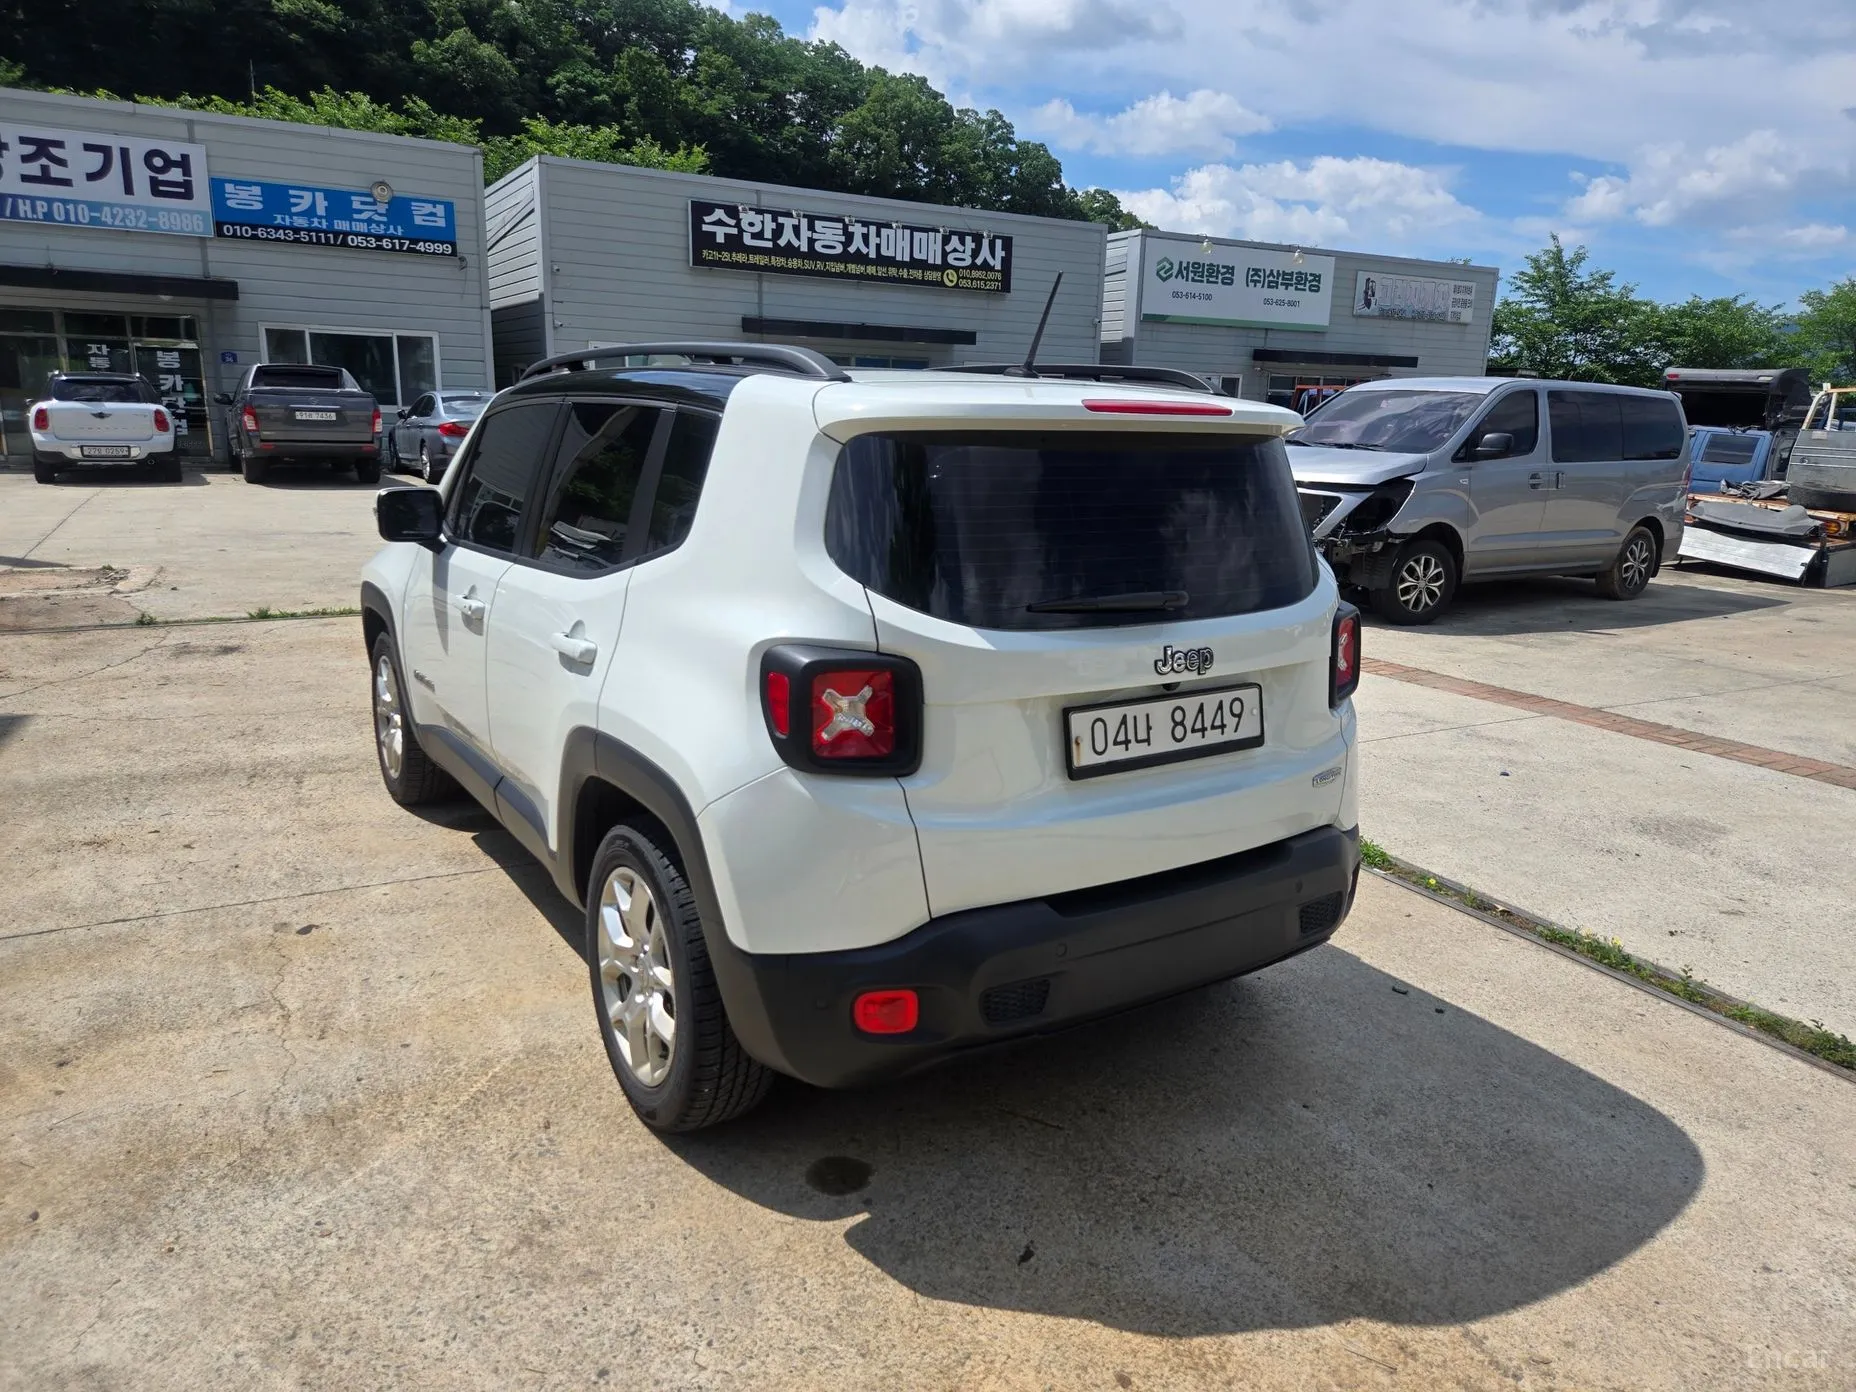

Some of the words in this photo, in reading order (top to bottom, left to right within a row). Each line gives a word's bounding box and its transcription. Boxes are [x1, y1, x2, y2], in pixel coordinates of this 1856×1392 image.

[0, 133, 195, 200] 조기업
[53, 202, 204, 232] 010-4232-8986
[273, 213, 329, 230] 자동차
[334, 219, 404, 236] 매매상사
[347, 235, 452, 255] 053-617-4999
[702, 208, 1006, 270] 수한자동차매매상사
[1174, 260, 1236, 286] 서원환경
[1245, 266, 1322, 293] (주)삼부환경
[1171, 290, 1213, 301] 053-614-5100
[1153, 645, 1215, 676] Jeep
[1091, 712, 1152, 756] 04나
[1170, 697, 1245, 743] 8449
